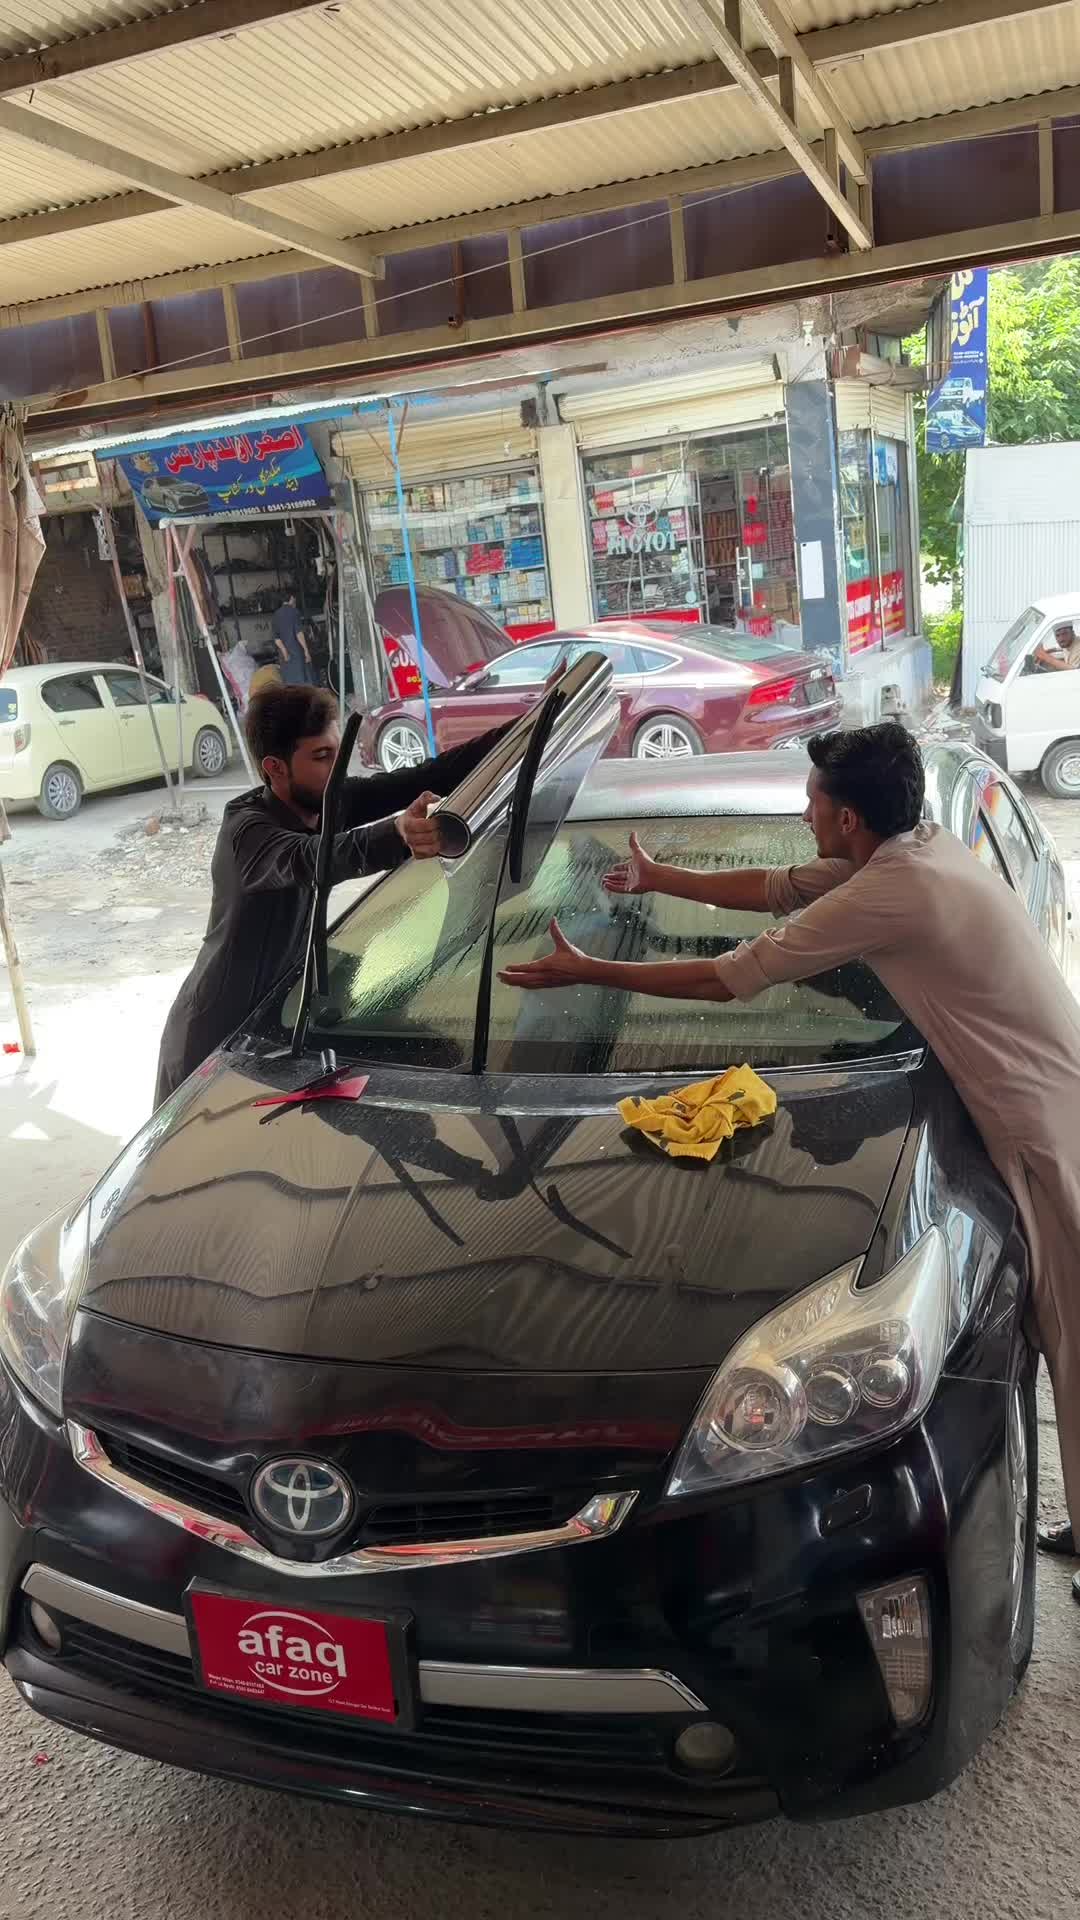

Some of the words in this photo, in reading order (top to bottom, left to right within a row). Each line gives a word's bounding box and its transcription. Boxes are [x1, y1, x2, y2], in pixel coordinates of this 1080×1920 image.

[238, 1625, 347, 1678] afaq
[255, 1660, 283, 1676] car
[288, 1665, 333, 1684] zone
